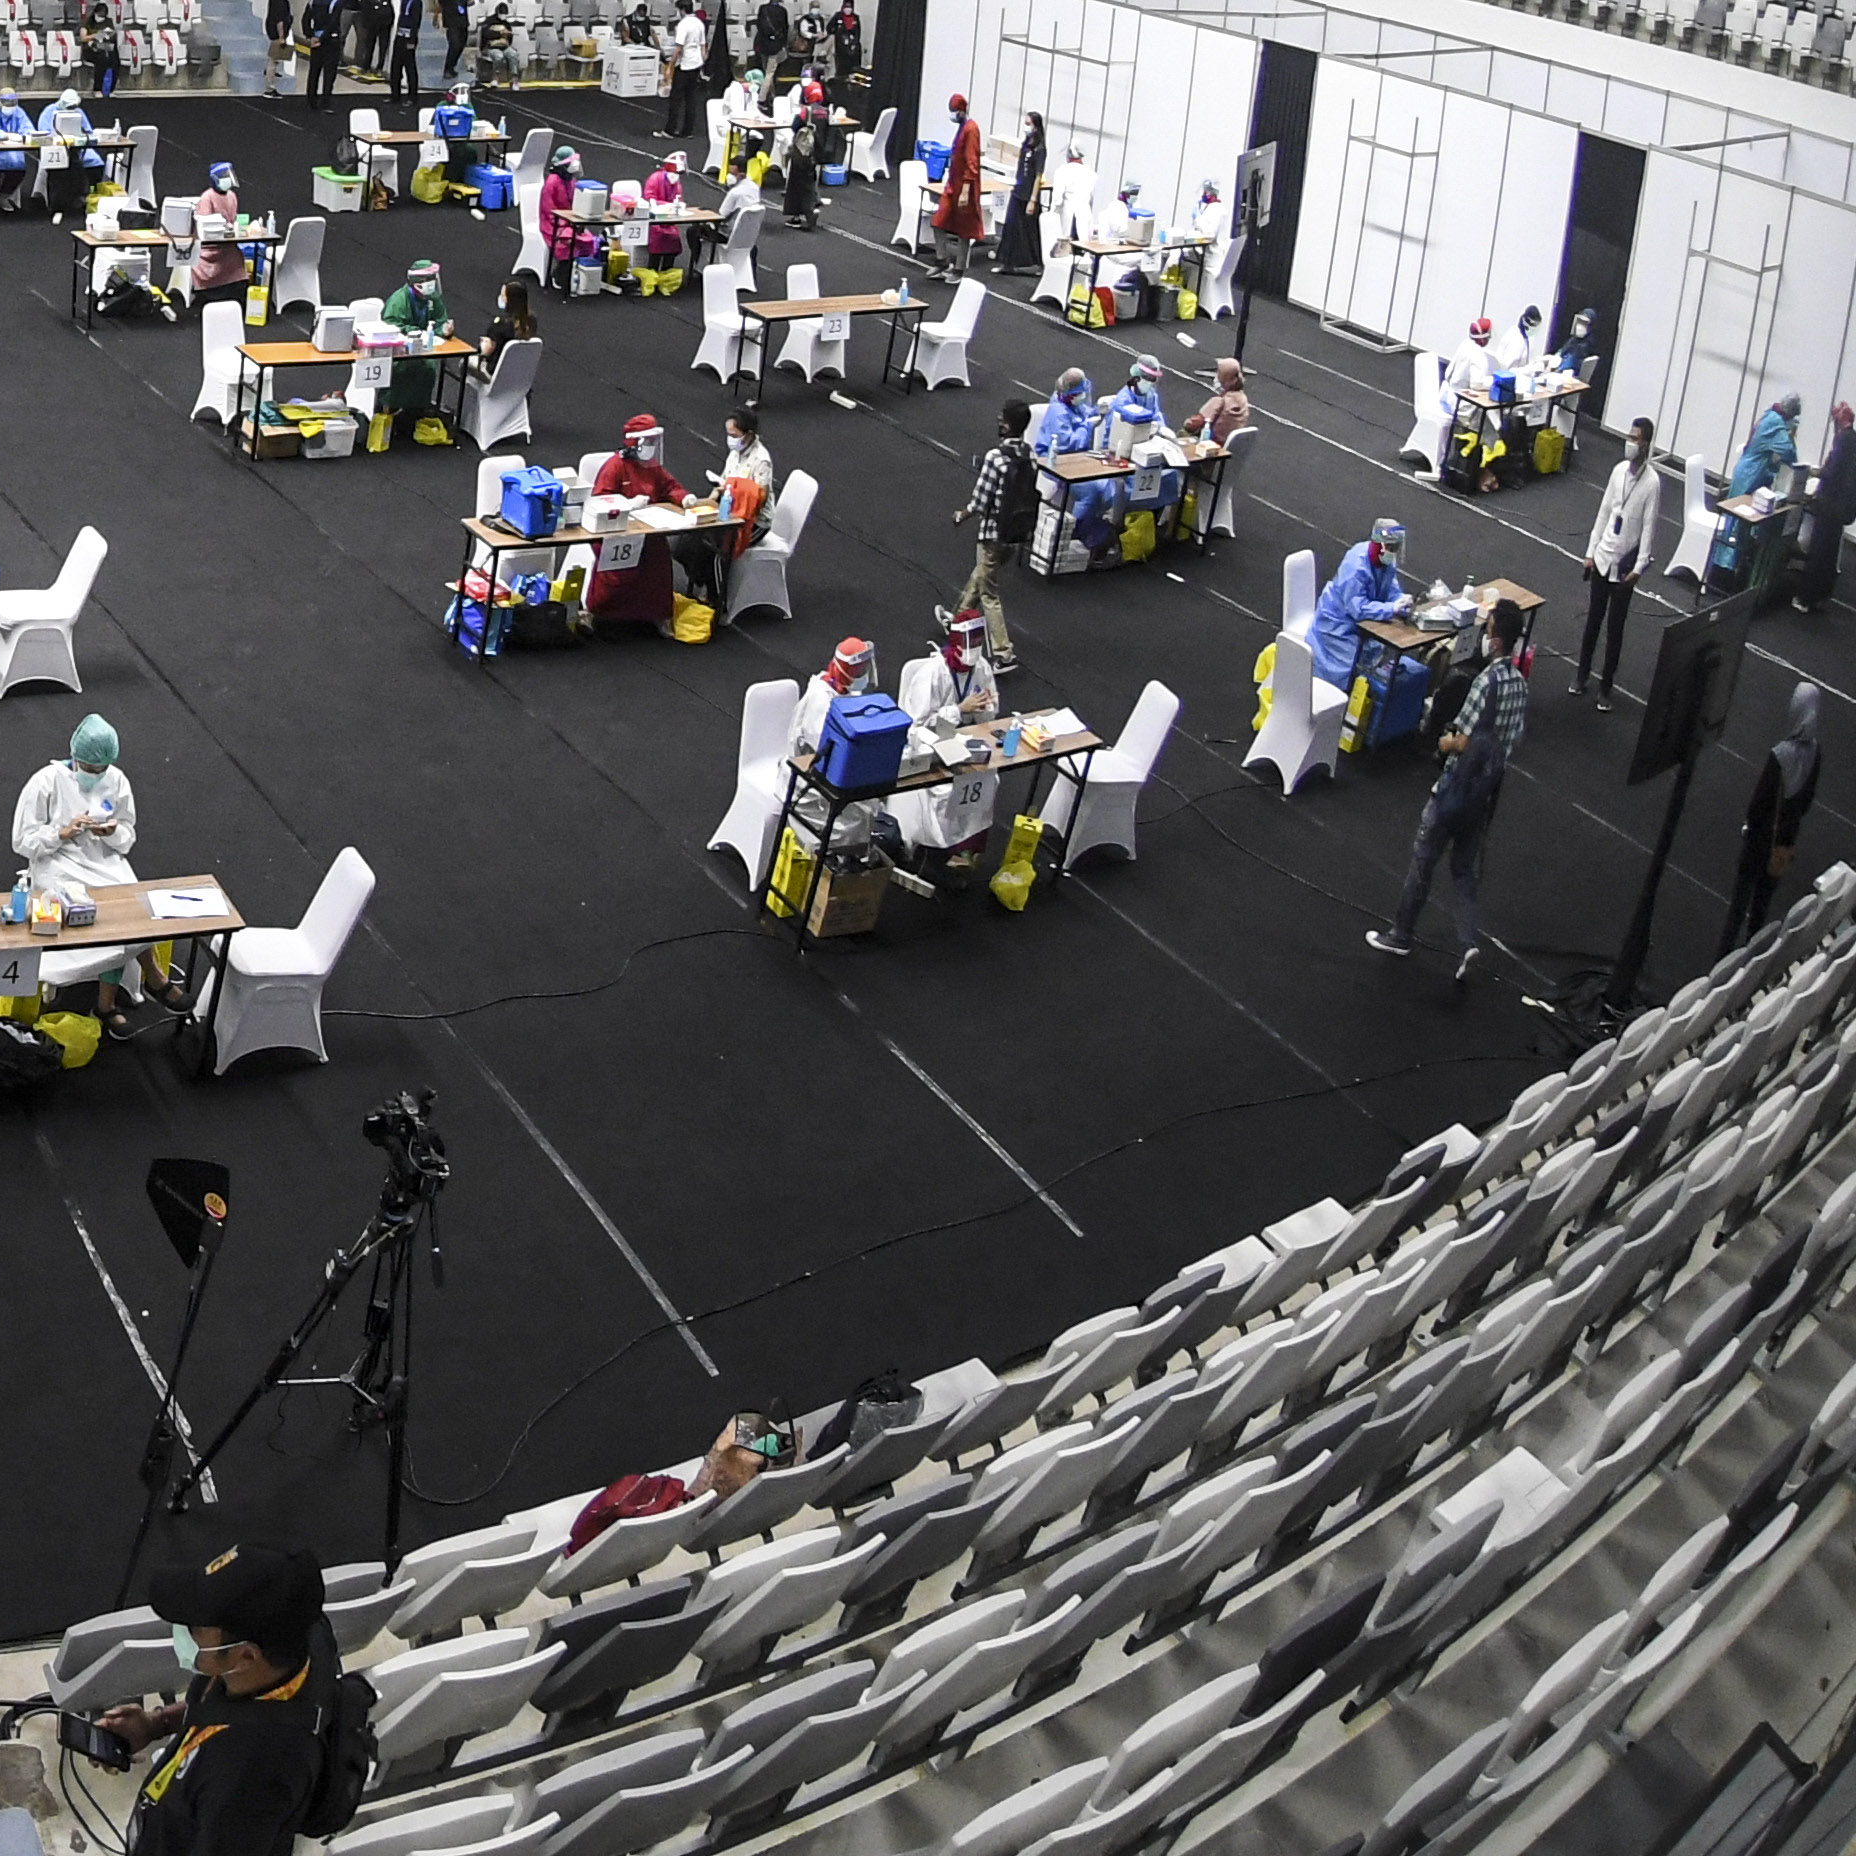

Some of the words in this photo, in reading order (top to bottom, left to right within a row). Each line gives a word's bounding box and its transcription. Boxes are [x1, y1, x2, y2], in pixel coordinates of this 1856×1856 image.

[48, 152, 61, 163] 21
[628, 227, 642, 240] 23
[829, 319, 842, 333] 23
[365, 365, 382, 381] 19
[1138, 475, 1154, 492] 22
[610, 543, 632, 562] 18
[959, 781, 983, 805] 18
